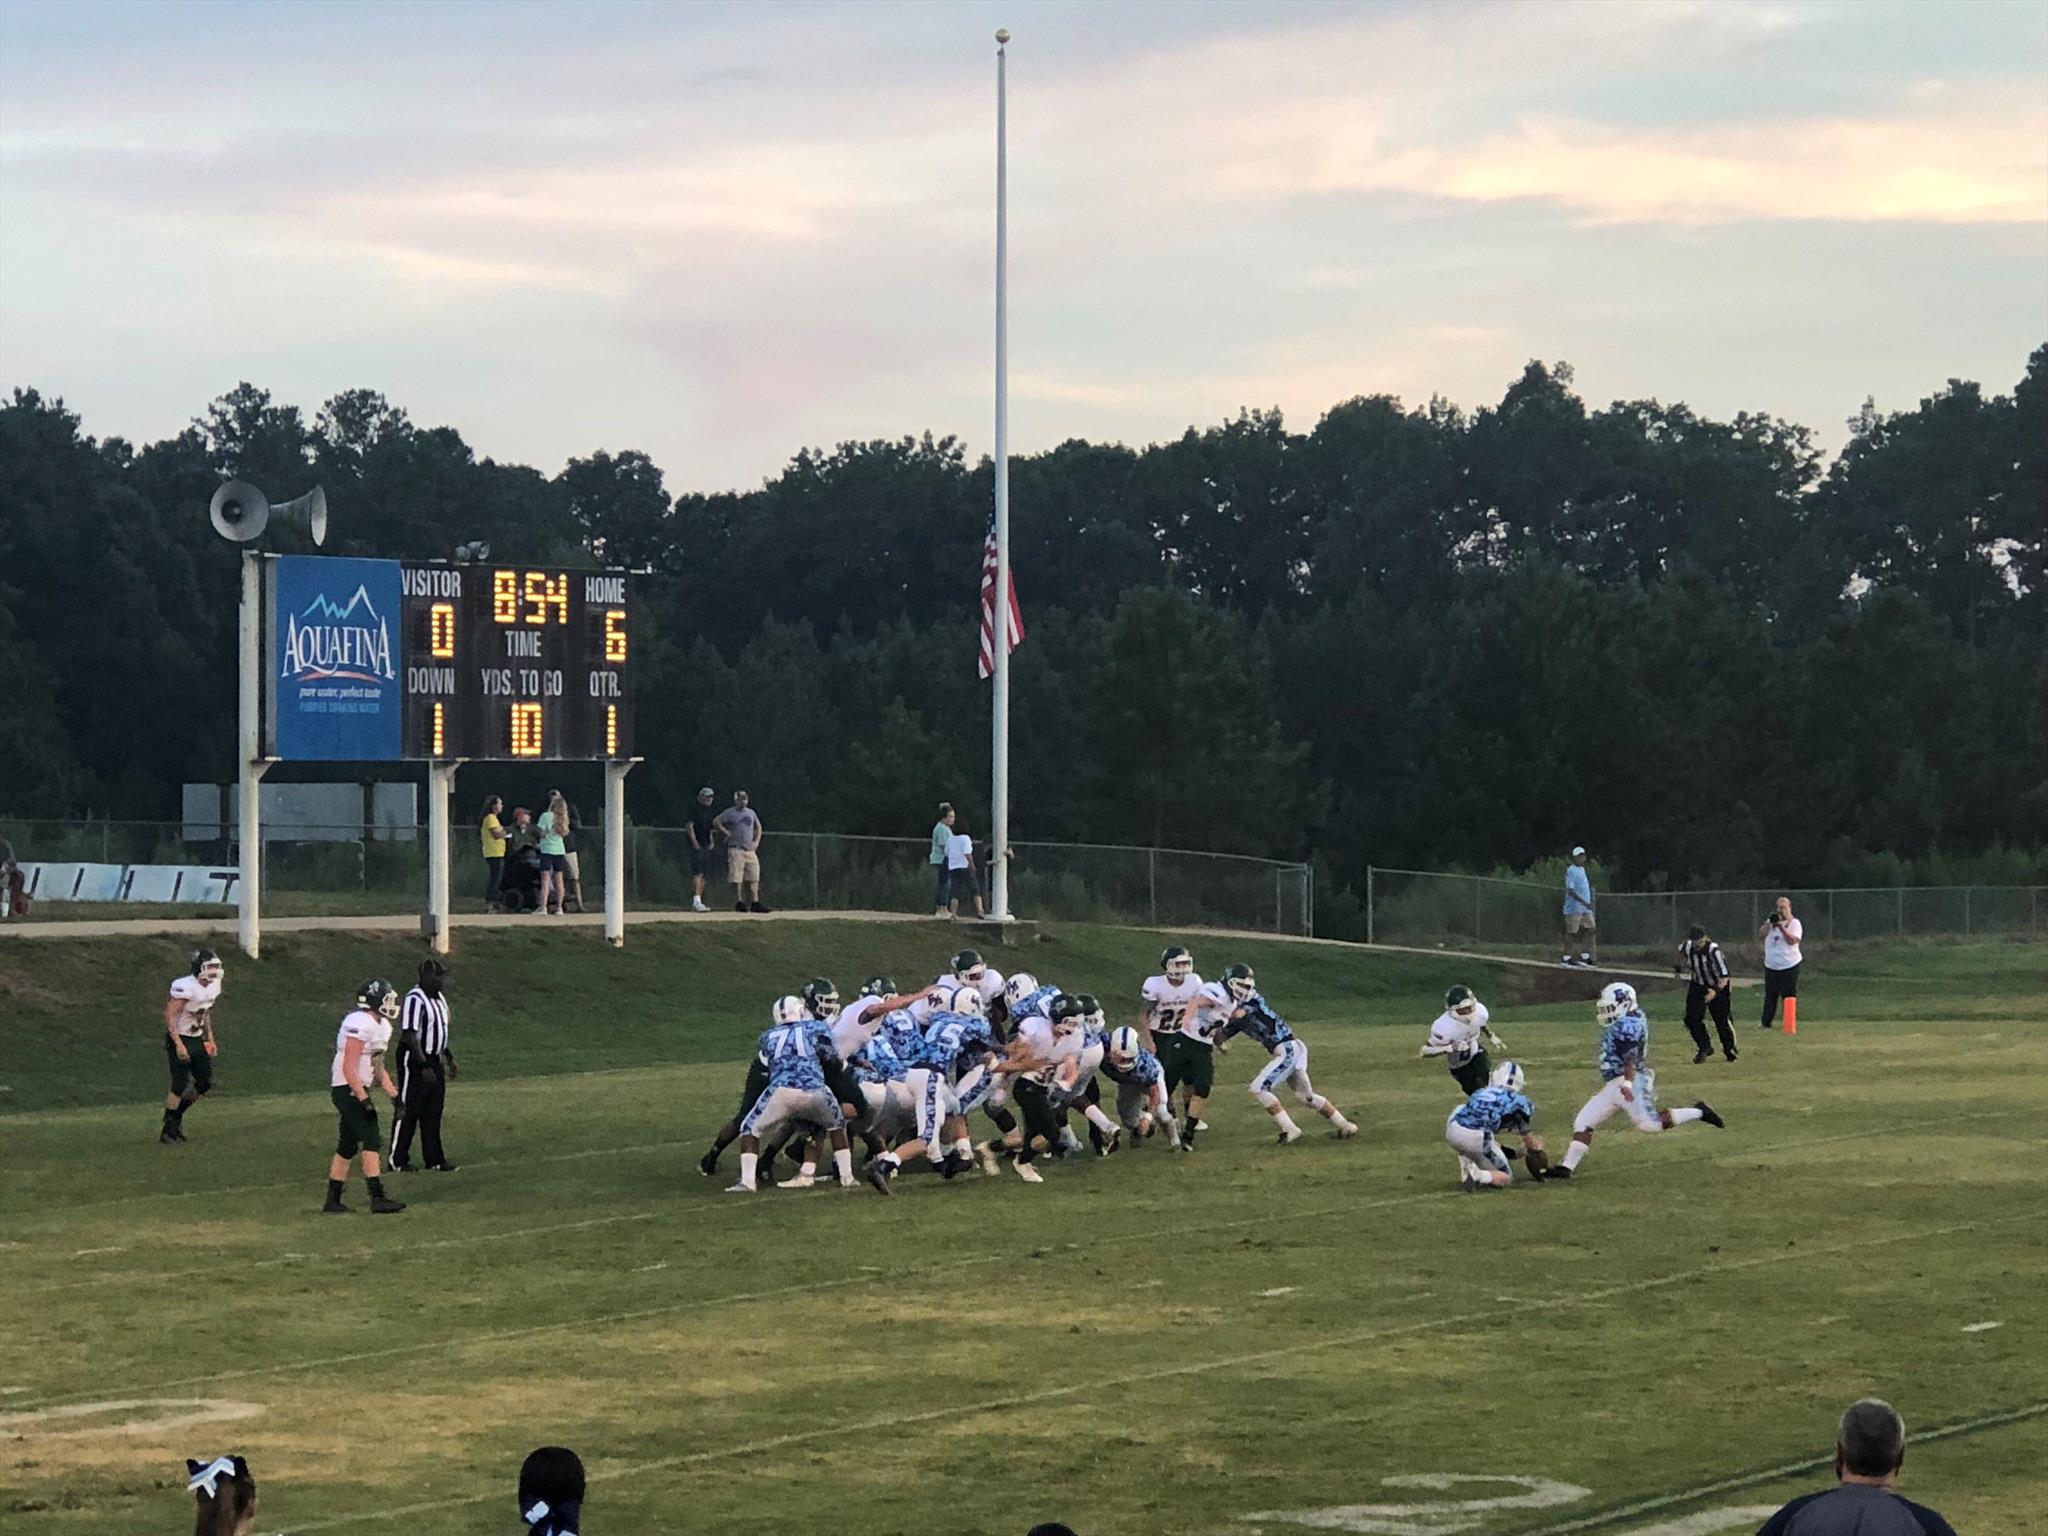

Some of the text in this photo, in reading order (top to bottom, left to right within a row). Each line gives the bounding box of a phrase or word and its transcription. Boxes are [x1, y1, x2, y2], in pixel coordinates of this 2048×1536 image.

[401, 568, 462, 598] VISITOR
[493, 569, 568, 625] 8:54
[585, 576, 625, 604] HOME
[281, 612, 395, 680] AQUAFINA
[431, 602, 455, 659] 0
[505, 630, 542, 658] TIME
[605, 610, 627, 662] 6
[408, 667, 455, 695] DOWN
[481, 668, 563, 697] YDS. TO GO
[589, 671, 622, 698] QTR.
[433, 702, 444, 756] 1
[511, 702, 544, 757] 10
[606, 704, 616, 756] 1
[768, 1026, 808, 1059] 71
